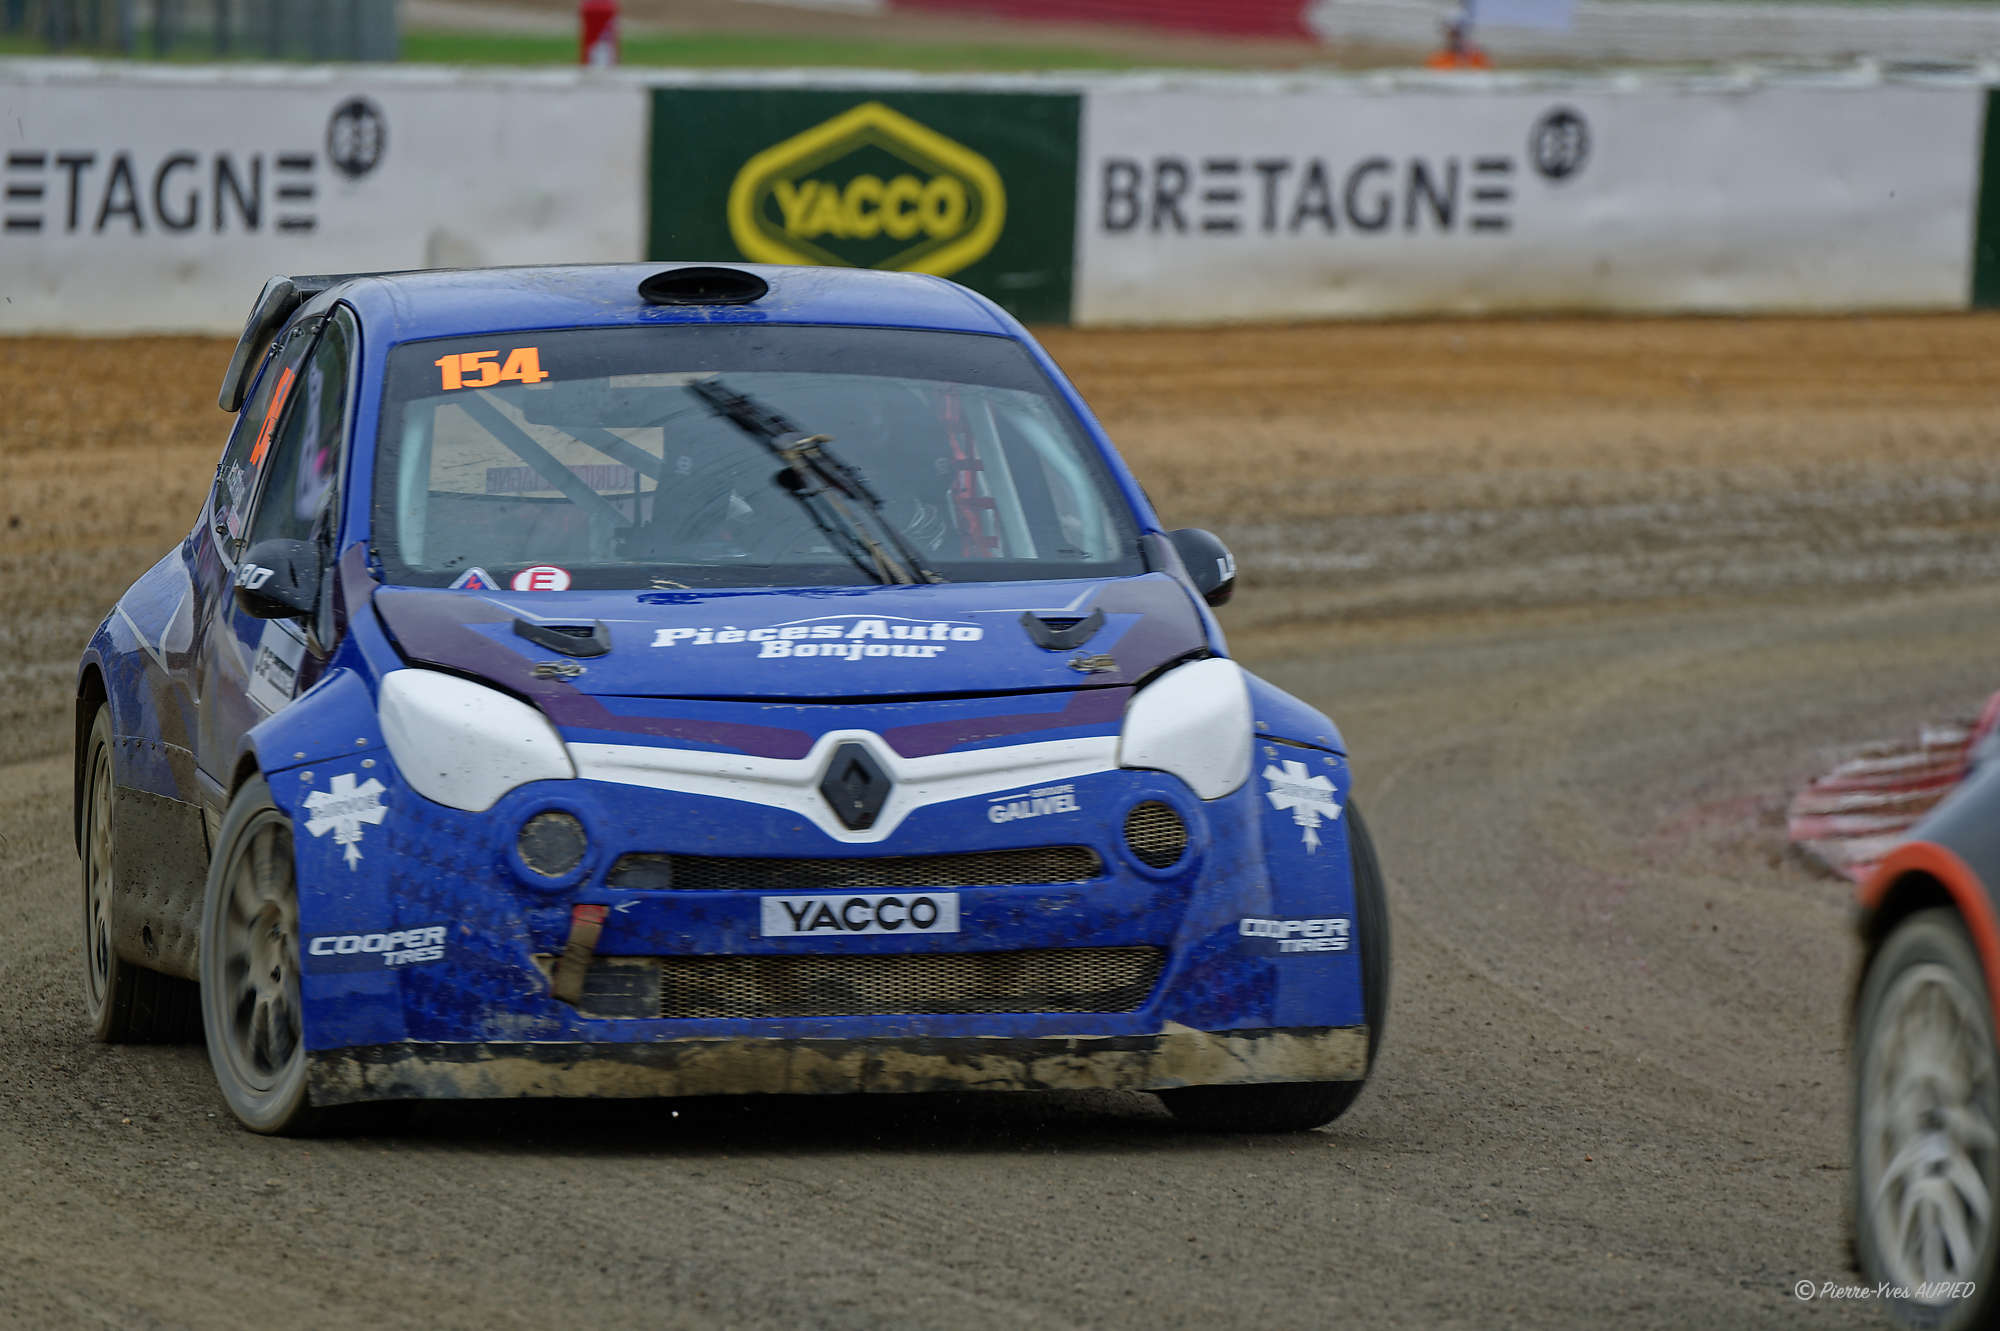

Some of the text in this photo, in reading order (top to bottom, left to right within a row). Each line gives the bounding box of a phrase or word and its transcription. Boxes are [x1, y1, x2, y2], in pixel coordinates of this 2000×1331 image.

[773, 174, 967, 240] YACCO
[1103, 157, 1513, 235] BRETAGNE
[434, 346, 550, 391] 154
[651, 619, 983, 647] Pièces Auto
[757, 640, 946, 661] Bonjour
[780, 896, 938, 931] YACCO
[1239, 918, 1350, 939] COOPER
[309, 926, 446, 956] COOPER
[381, 945, 446, 966] TIRES
